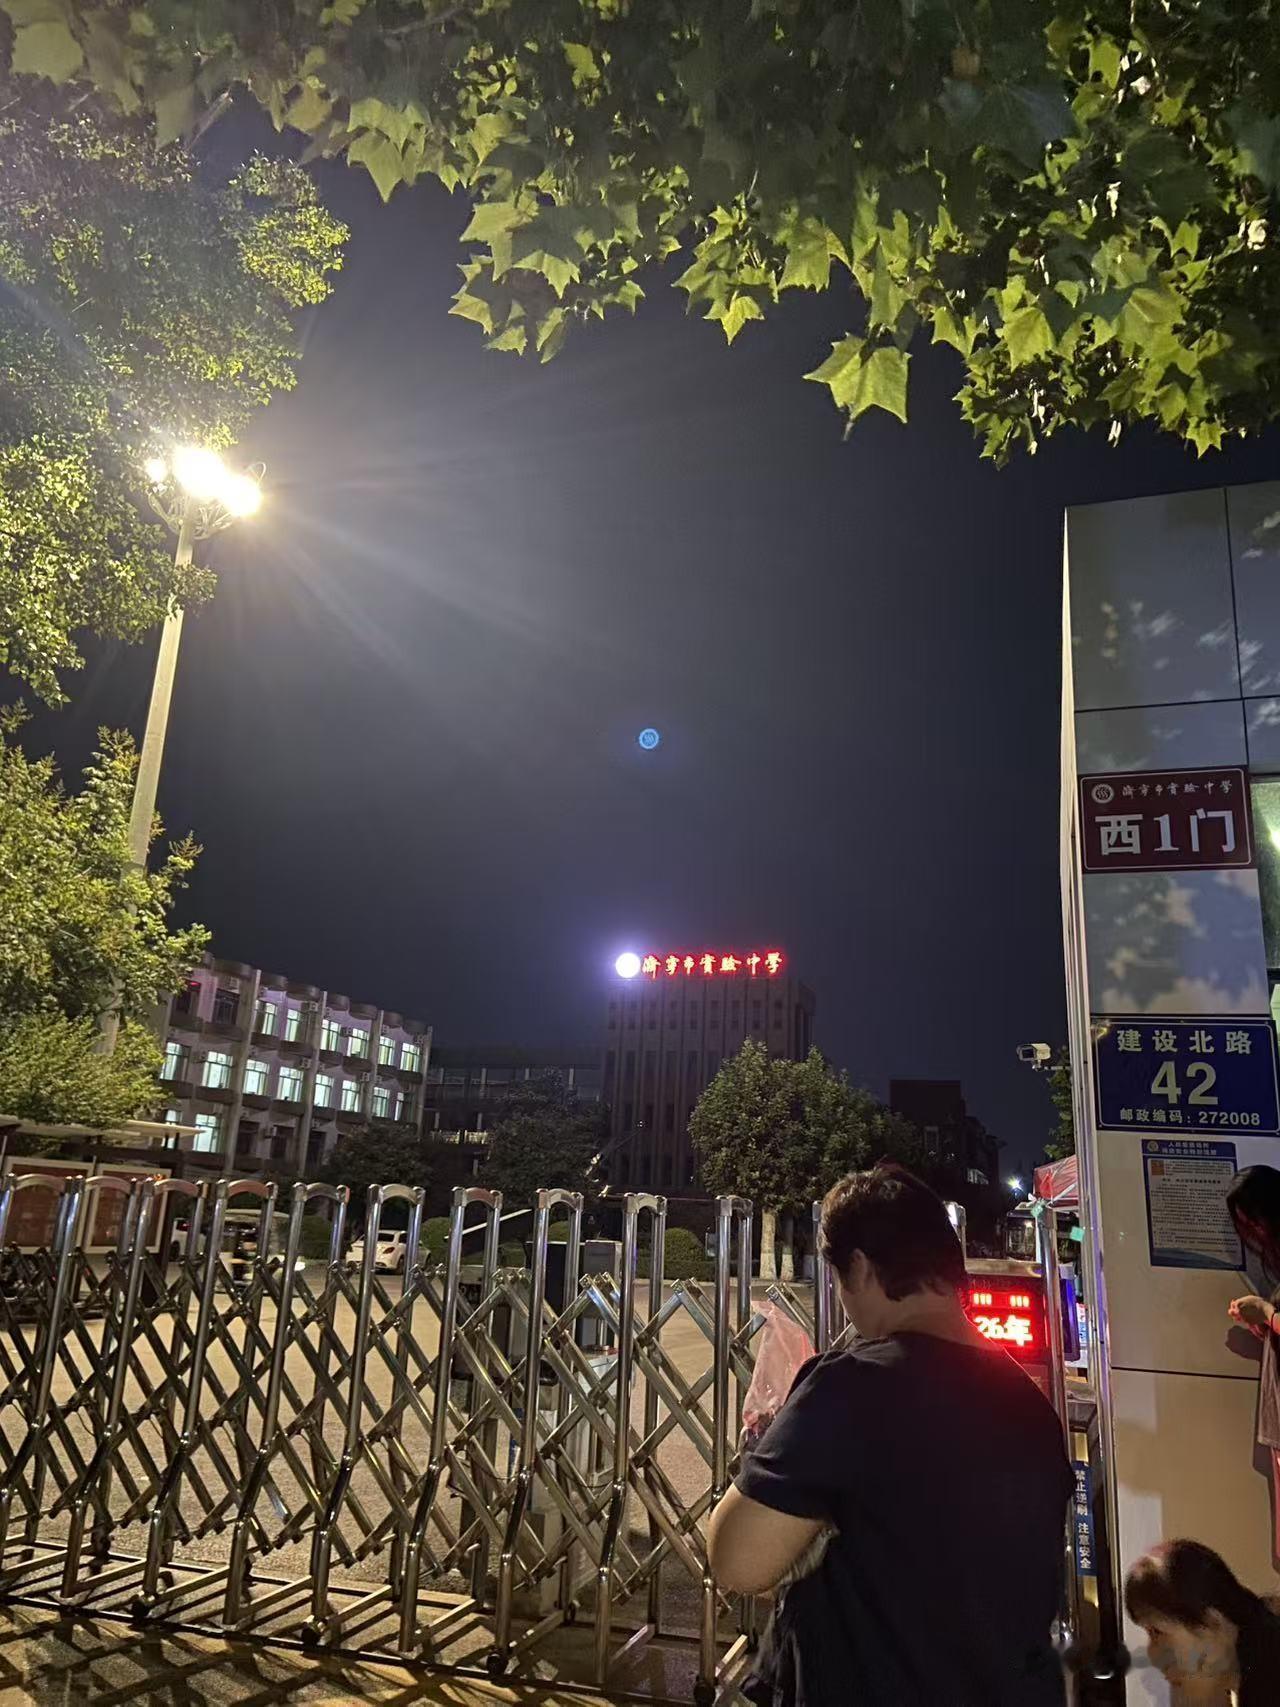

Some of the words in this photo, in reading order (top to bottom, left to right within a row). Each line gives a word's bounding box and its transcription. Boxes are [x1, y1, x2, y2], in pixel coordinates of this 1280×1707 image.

[1094, 808, 1236, 856] 西1门
[1117, 1029, 1252, 1055] 建设北路
[1151, 1060, 1219, 1105] 42
[973, 1314, 1033, 1347] 26年
[1078, 1522, 1092, 1569] 注意安全
